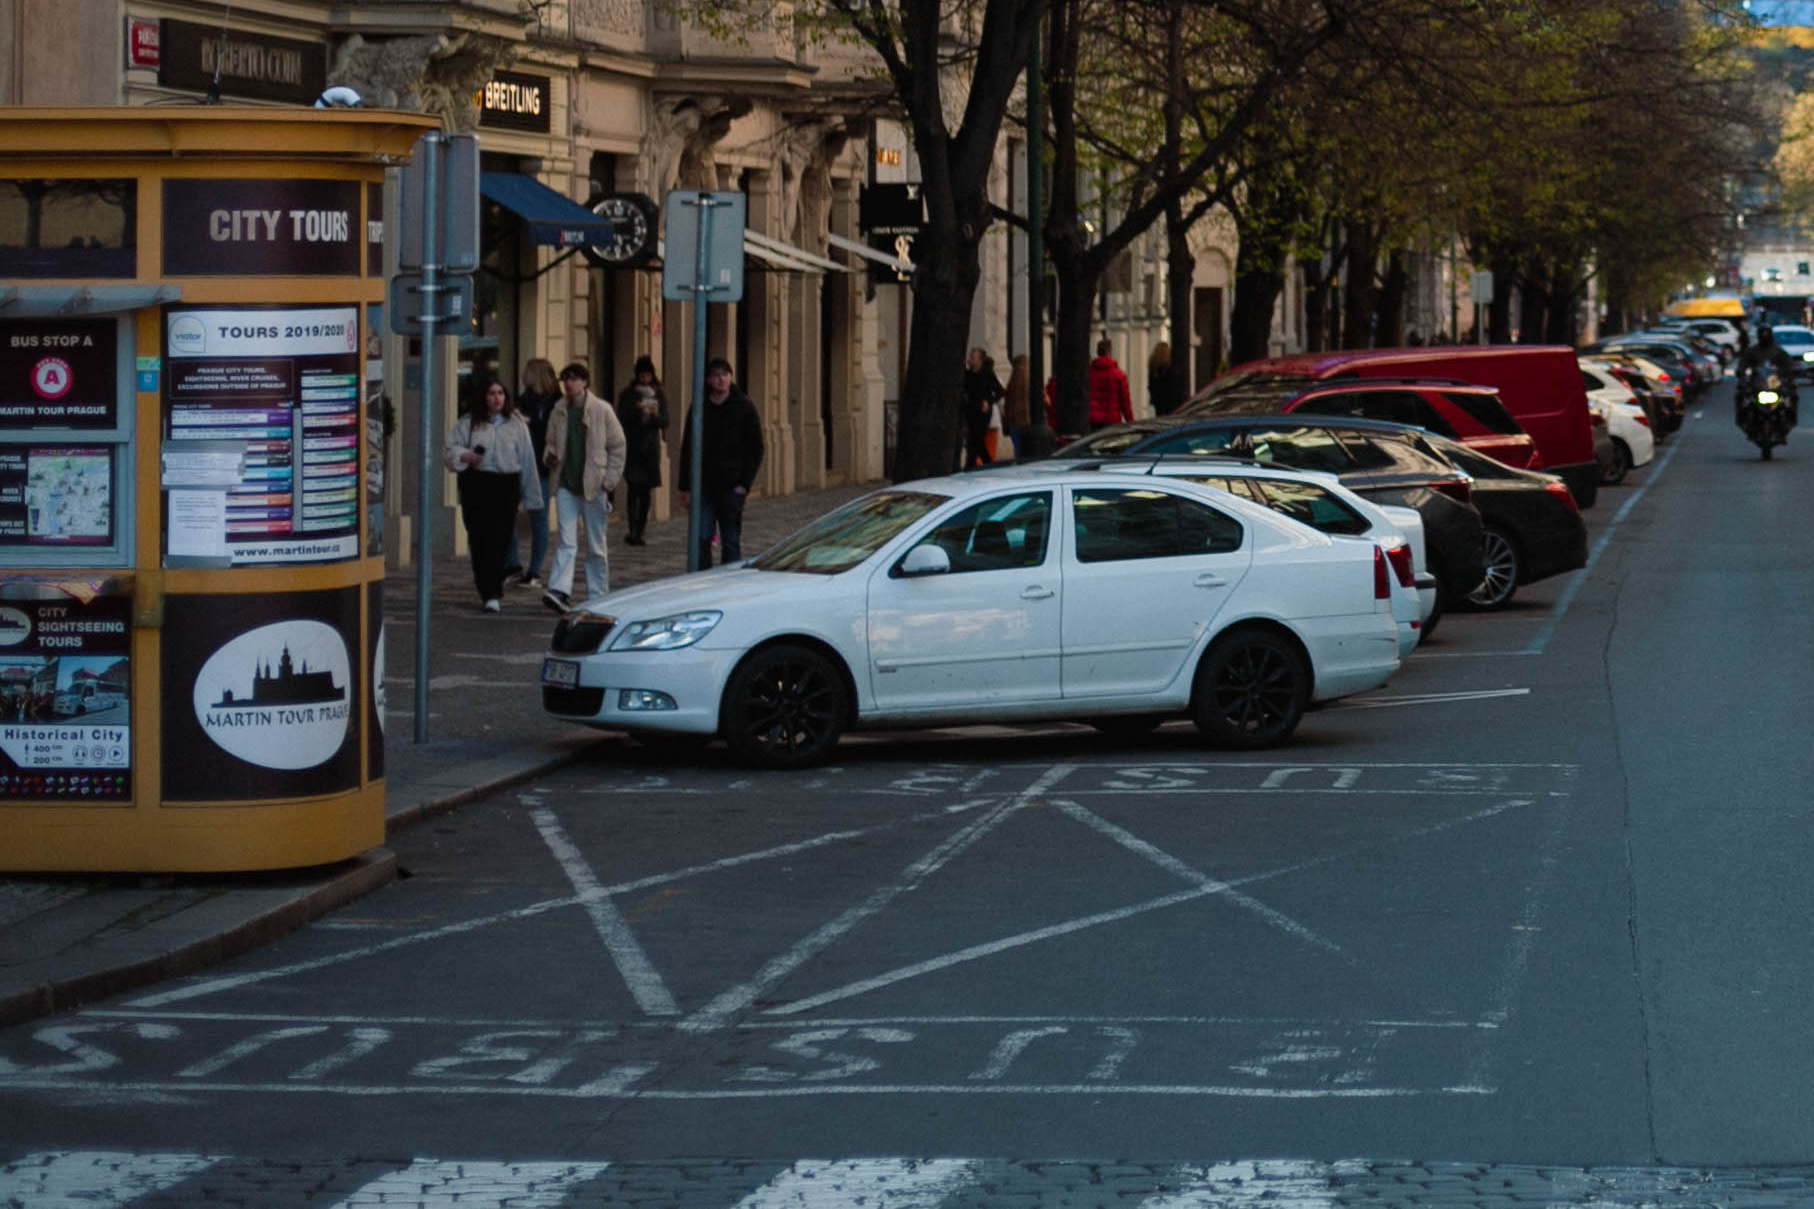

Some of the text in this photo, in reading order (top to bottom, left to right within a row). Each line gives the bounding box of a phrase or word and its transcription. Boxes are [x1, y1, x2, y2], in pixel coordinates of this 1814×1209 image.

[485, 81, 541, 115] BREITLING
[209, 209, 349, 242] CITY TOURS
[218, 326, 279, 339] TOURS
[285, 324, 345, 338] 2019/2020
[10, 335, 94, 347] BUS STOP A
[44, 370, 60, 385] A
[0, 405, 107, 415] MARTIN TOUR PRAGUE
[233, 545, 341, 558] www.martintour.cz
[37, 607, 67, 618] CITY
[37, 622, 125, 633] SIGHTSEEING
[37, 636, 83, 647] TOURS
[205, 711, 273, 728] MARTIN
[278, 708, 315, 725] TOUR
[4, 730, 123, 744] Historical City
